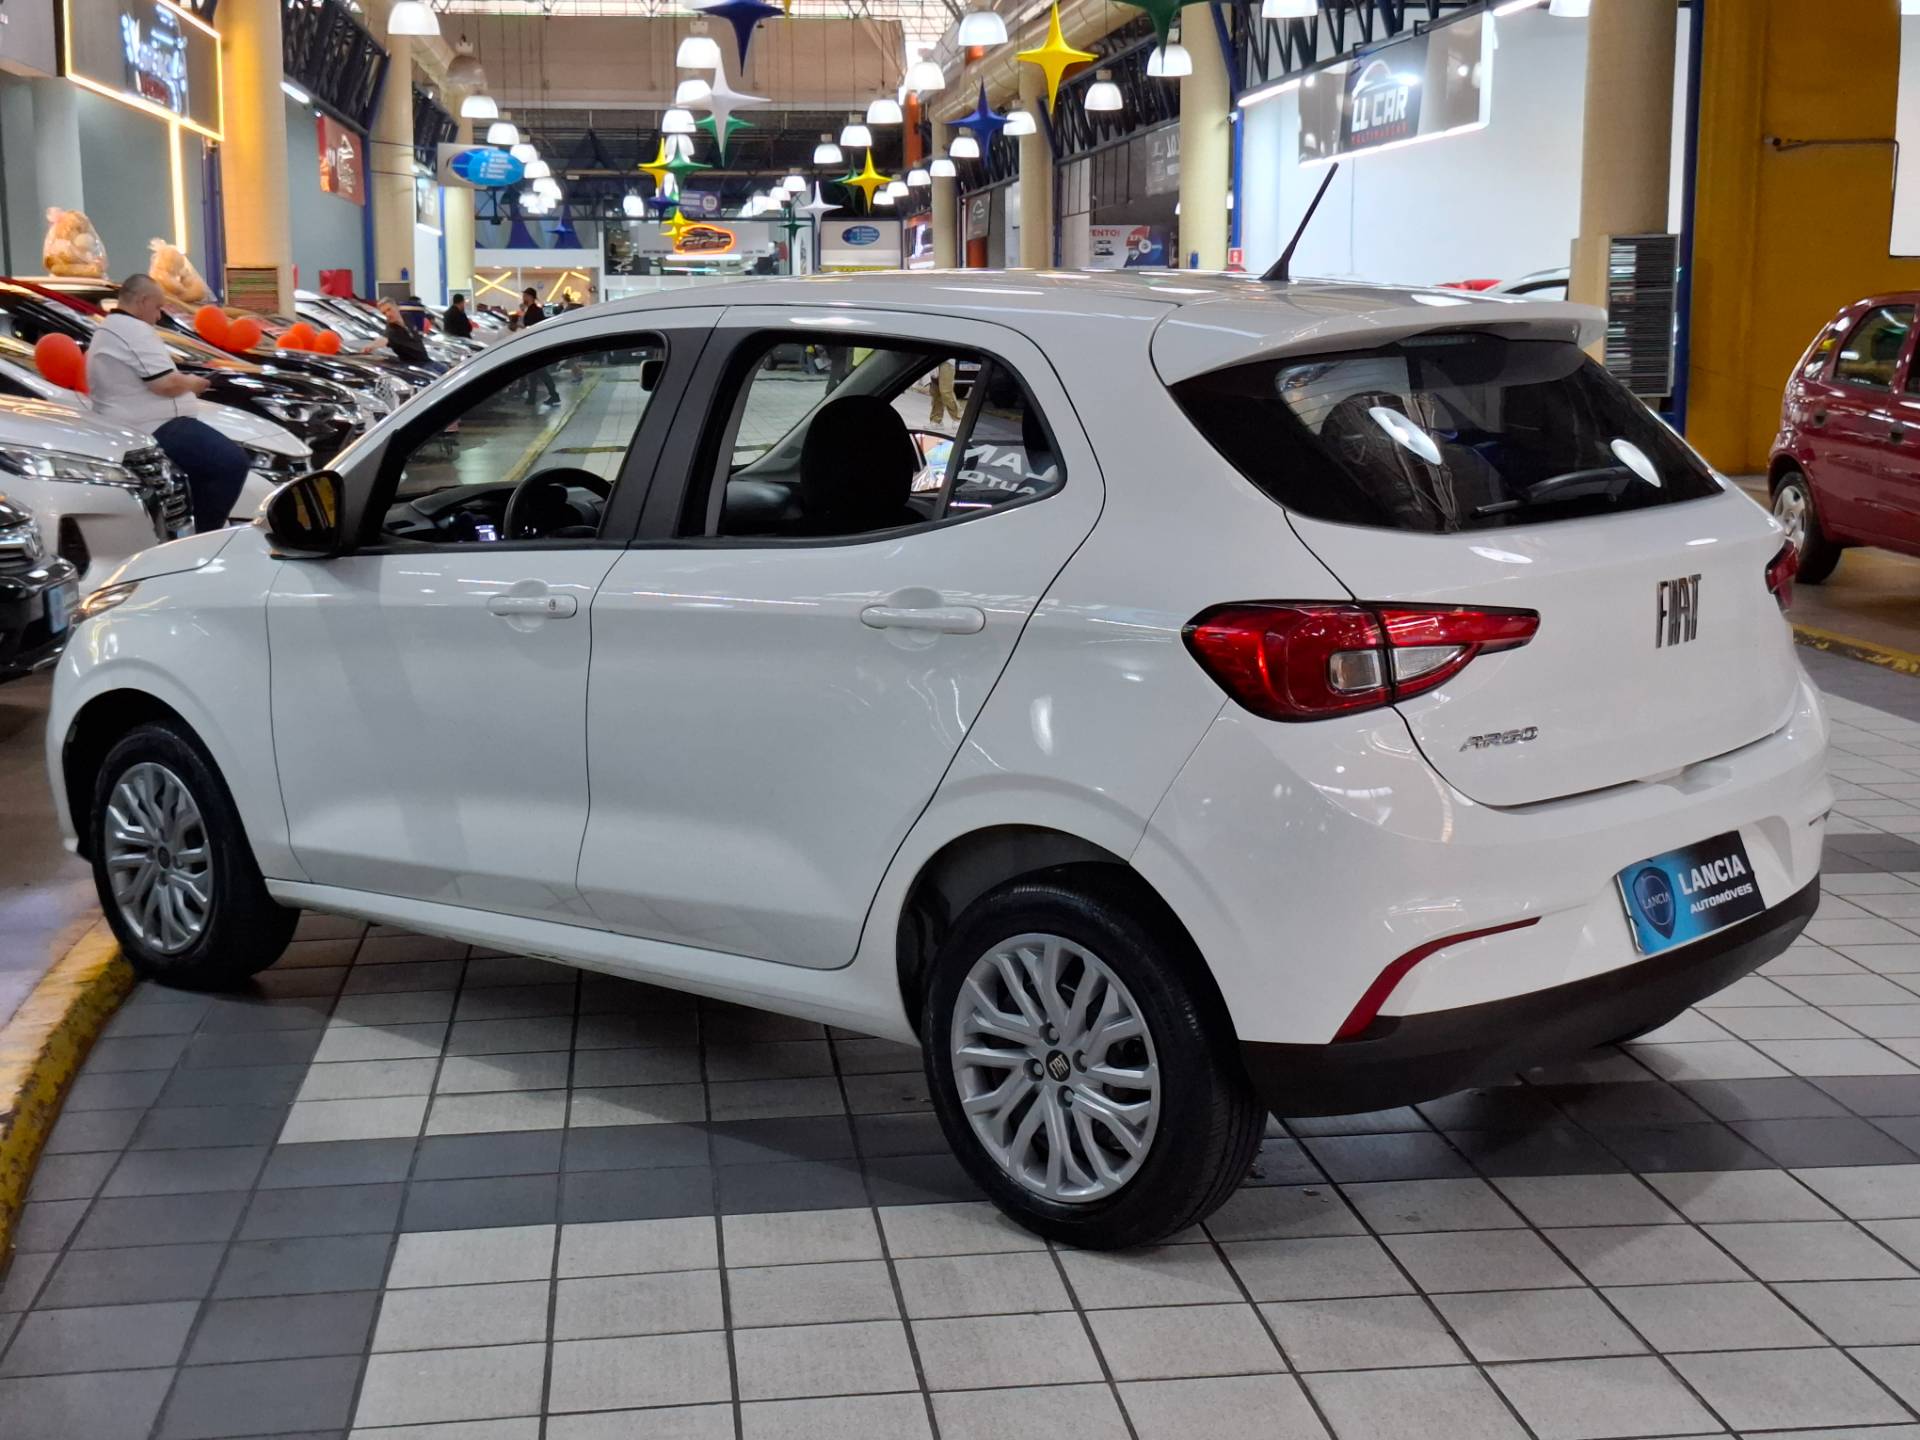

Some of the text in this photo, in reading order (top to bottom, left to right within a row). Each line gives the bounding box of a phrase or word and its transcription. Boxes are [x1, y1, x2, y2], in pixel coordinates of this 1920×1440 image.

[1371, 86, 1409, 127] CAR
[1655, 574, 1702, 649] FIAT
[1459, 726, 1539, 752] ARGO
[1678, 854, 1747, 896] LANCIA
[1642, 891, 1671, 910] LANCIA
[1690, 882, 1754, 914] AUTOMÓVEIS
[1049, 1054, 1069, 1079] FIAT
